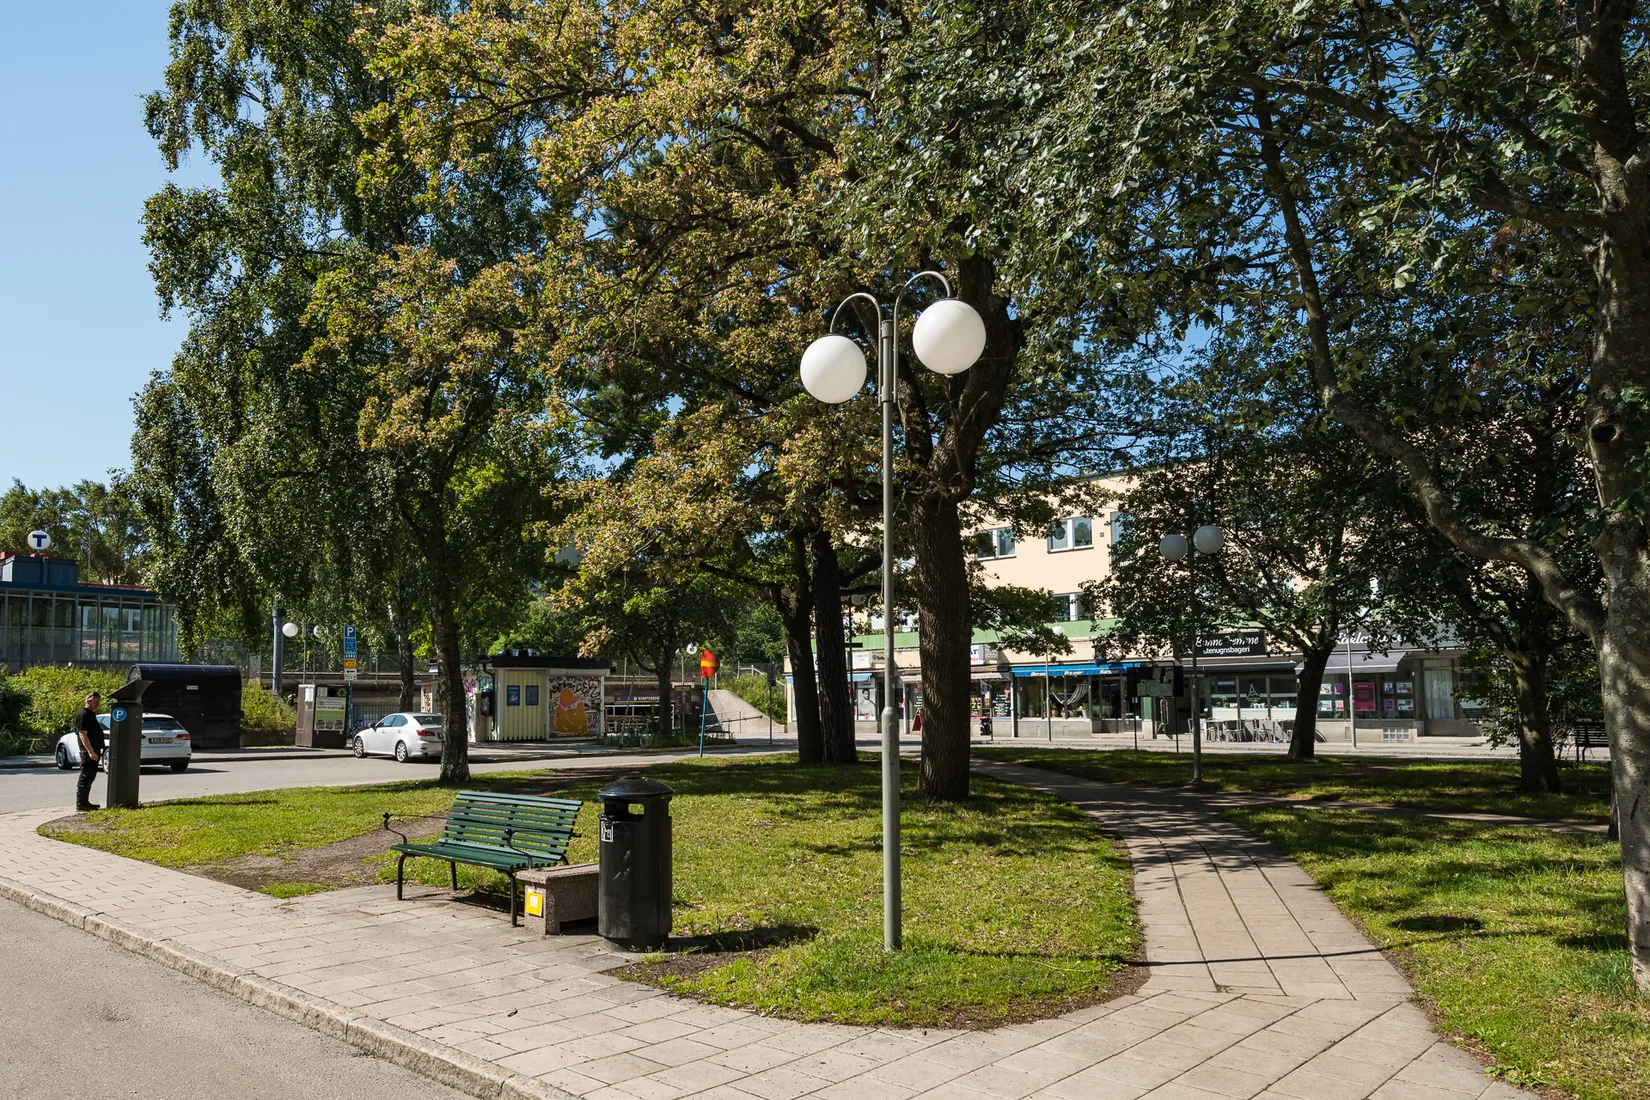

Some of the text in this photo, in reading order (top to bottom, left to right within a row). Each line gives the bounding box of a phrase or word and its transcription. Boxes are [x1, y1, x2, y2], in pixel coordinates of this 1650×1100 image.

[32, 534, 47, 548] T
[346, 626, 354, 637] P
[1195, 636, 1223, 647] Bnne
[116, 710, 124, 719] P
